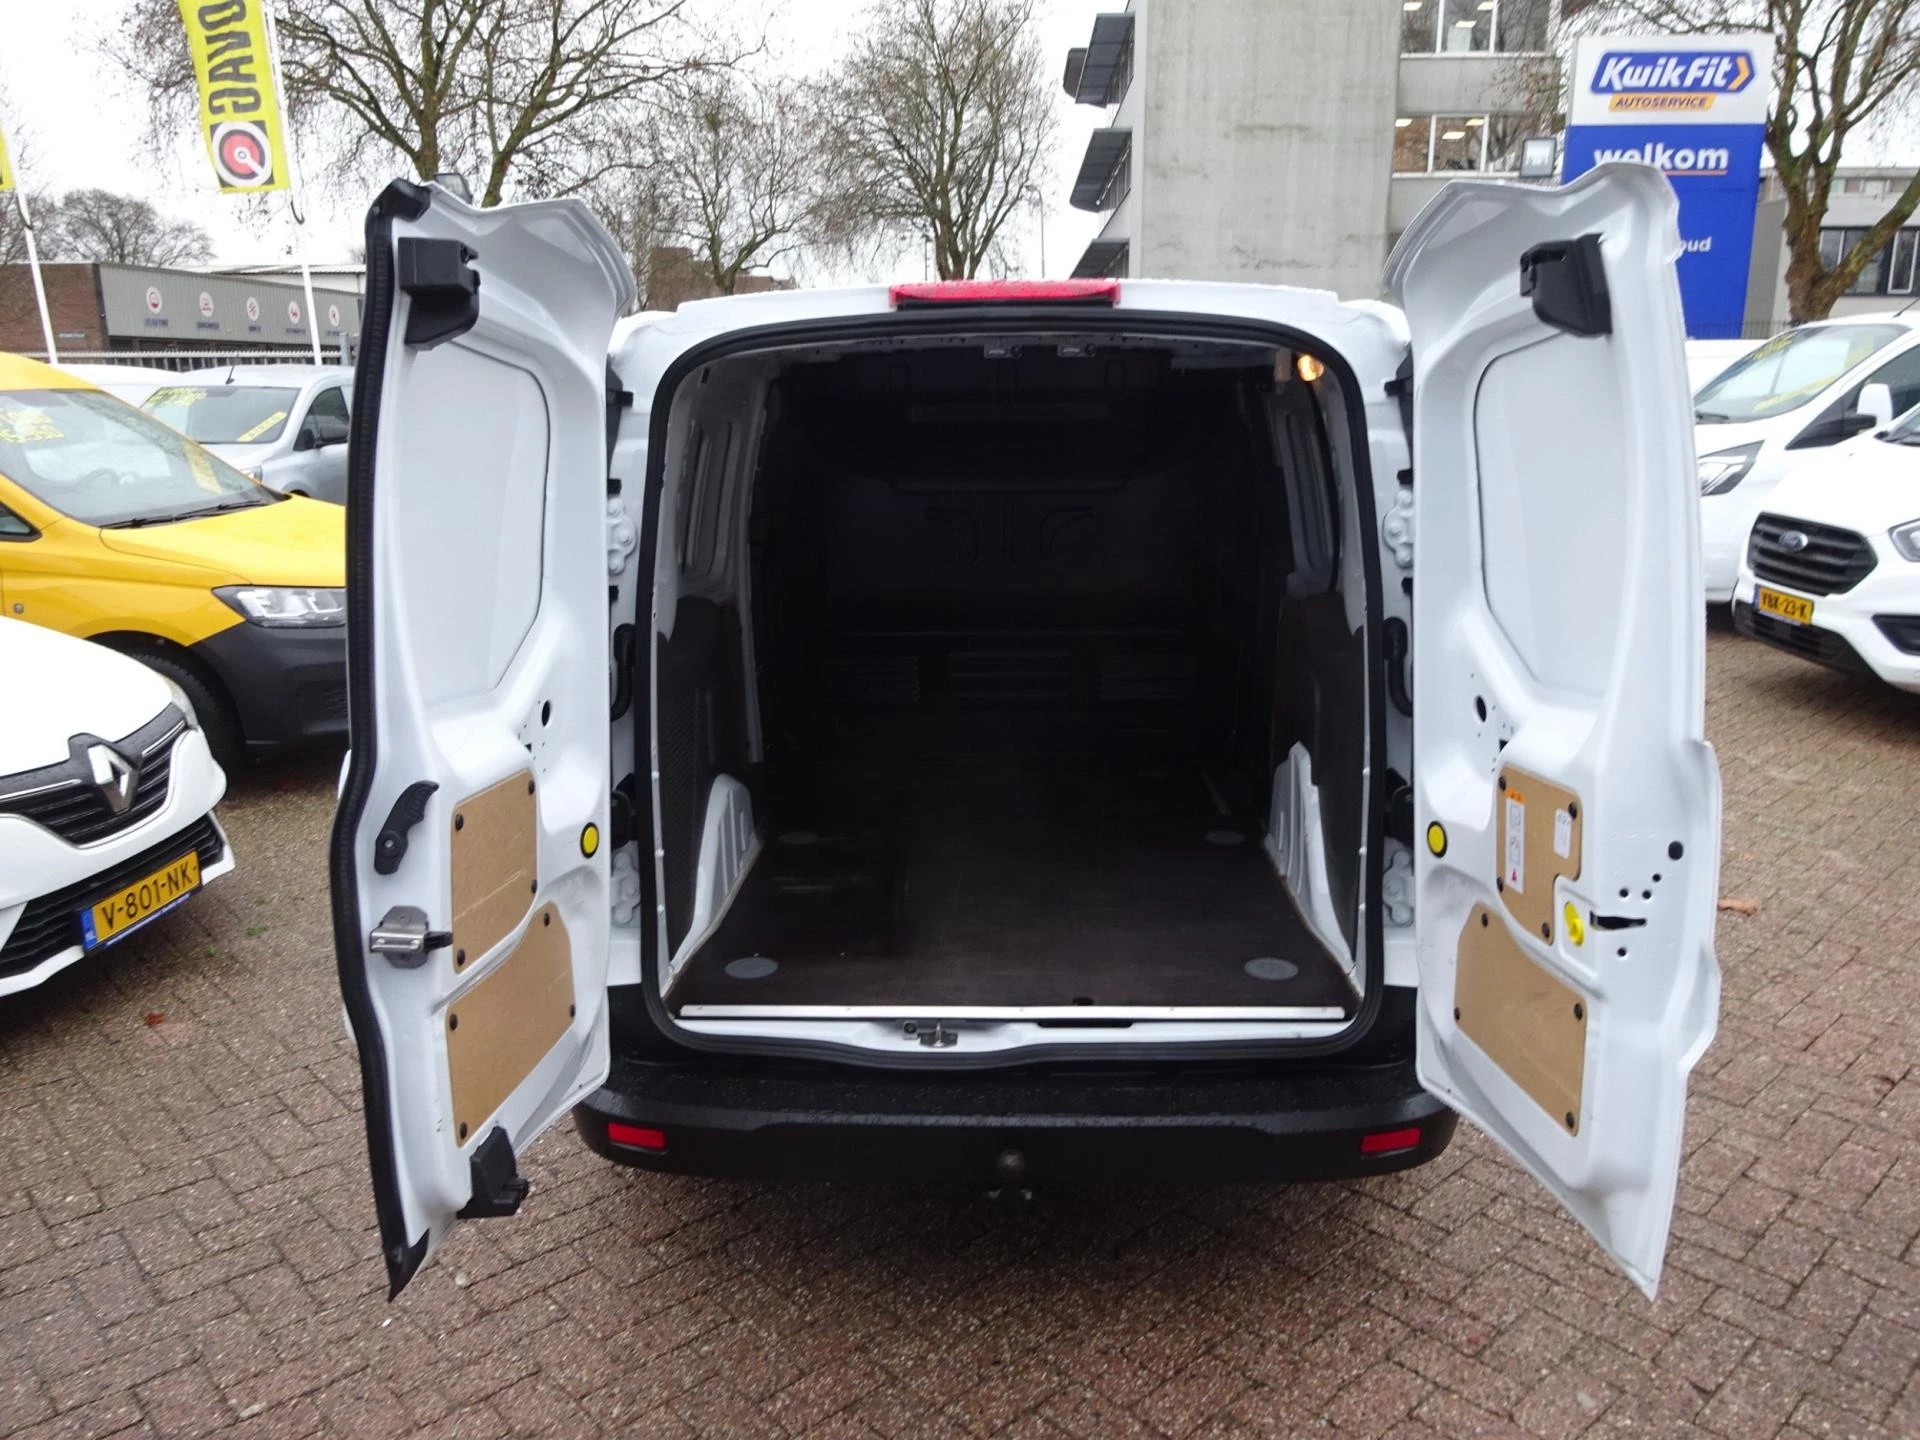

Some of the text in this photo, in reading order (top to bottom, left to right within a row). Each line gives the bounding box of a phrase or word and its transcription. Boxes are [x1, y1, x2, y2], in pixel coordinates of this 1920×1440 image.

[1614, 95, 1707, 109] AUTOSERVICE
[1593, 142, 1729, 170] welkom
[101, 860, 193, 930] V-801-NK
